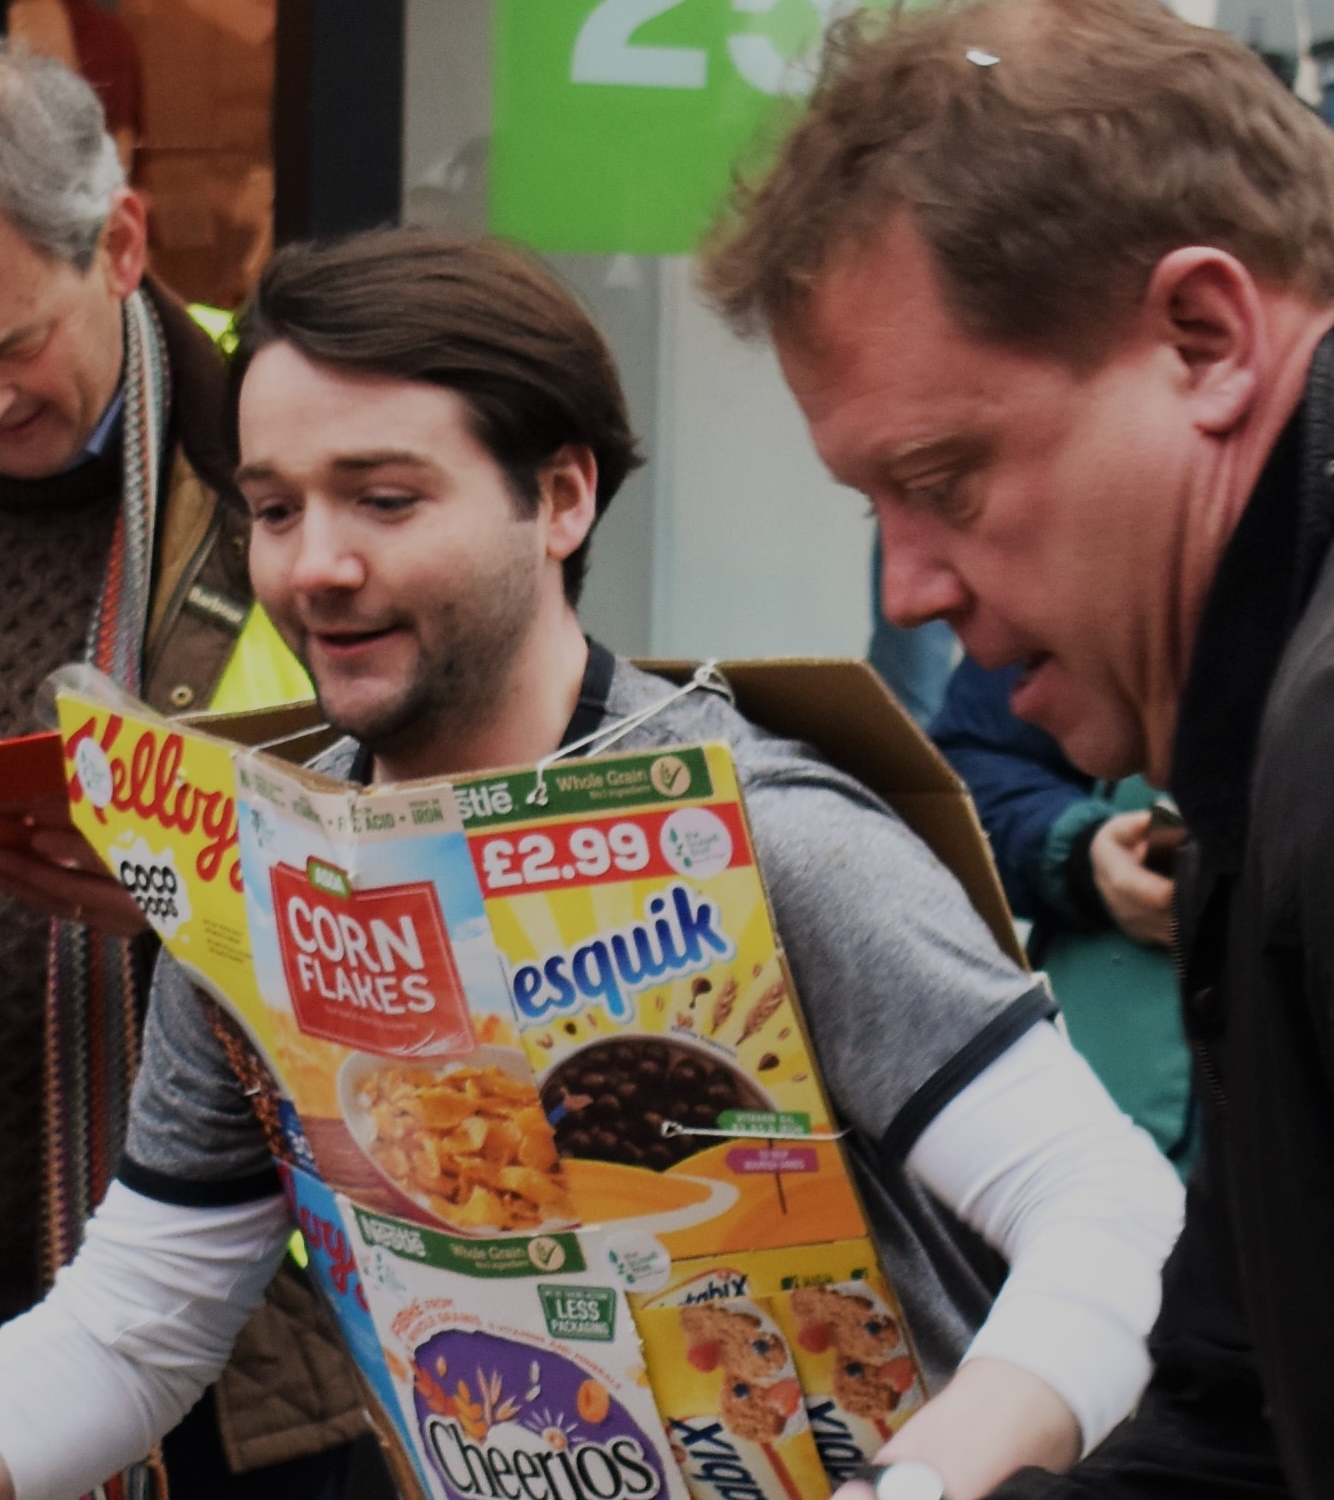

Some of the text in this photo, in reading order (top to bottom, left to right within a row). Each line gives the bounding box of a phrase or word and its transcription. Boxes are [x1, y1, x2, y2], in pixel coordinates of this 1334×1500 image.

[483, 822, 651, 890] £2.99
[287, 896, 425, 973] CORN
[513, 886, 729, 1018] esquik
[296, 953, 436, 1015] FLAKES
[555, 1299, 601, 1321] LESS
[678, 1274, 748, 1307] tabix
